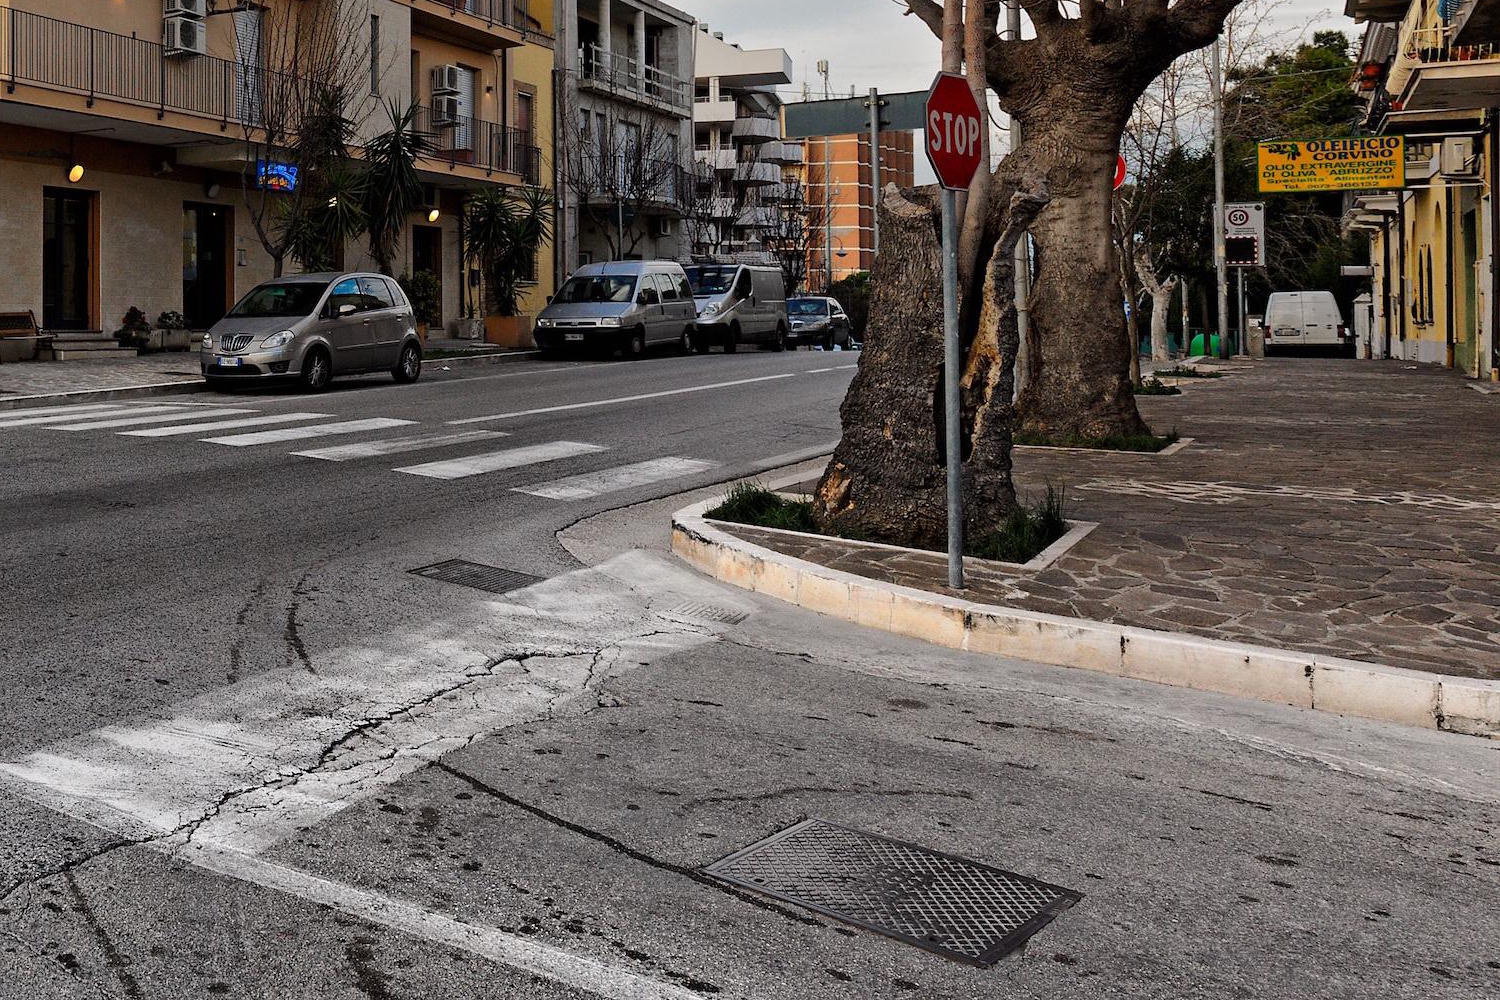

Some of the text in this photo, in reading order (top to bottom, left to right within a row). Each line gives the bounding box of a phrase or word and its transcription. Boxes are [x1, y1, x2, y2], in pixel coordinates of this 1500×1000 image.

[930, 110, 979, 157] STOP
[1306, 137, 1400, 152] OLEIFICIO
[1313, 149, 1393, 160] CORVINO
[1301, 160, 1397, 169] EXTRAVERGINE
[1232, 213, 1245, 222] 50
